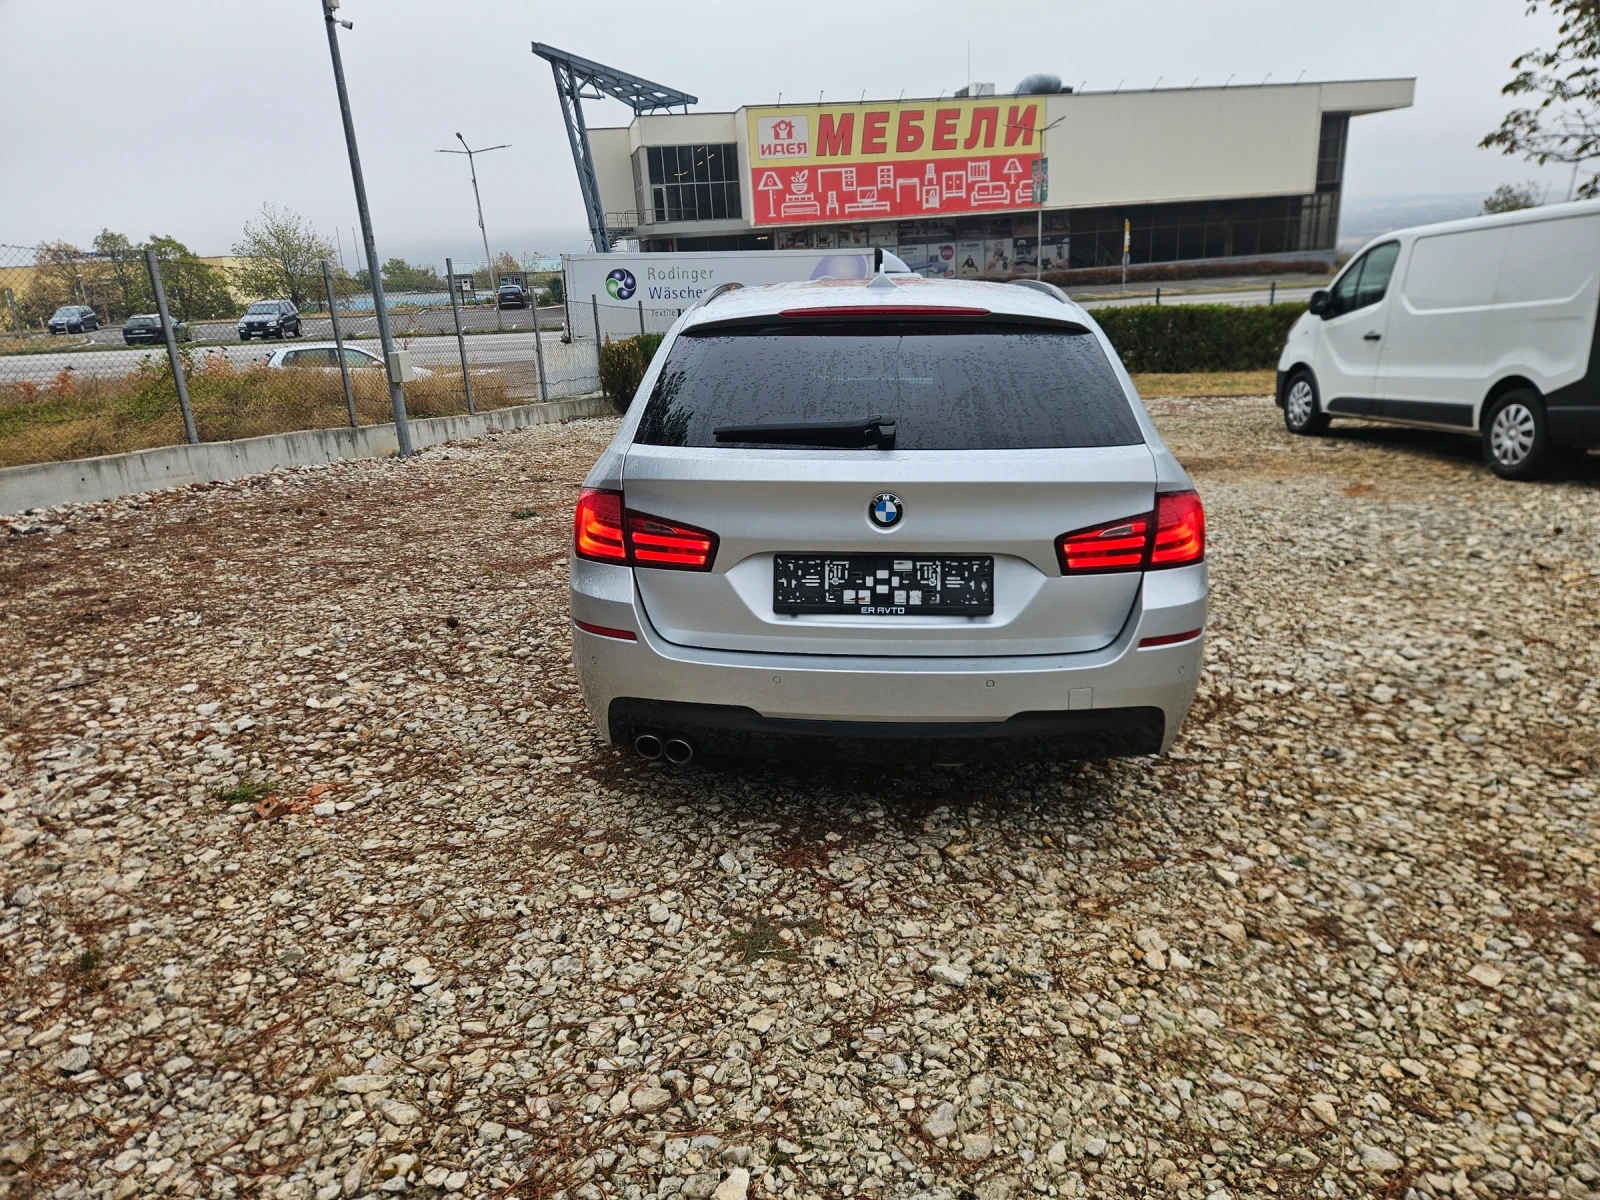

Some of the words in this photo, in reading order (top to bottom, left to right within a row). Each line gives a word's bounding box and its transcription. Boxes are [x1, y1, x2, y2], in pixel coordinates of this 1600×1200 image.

[816, 104, 1038, 156] МЕБЕЛИ
[760, 142, 808, 156] ИДЕЯ
[647, 267, 714, 282] Rodinger
[651, 309, 676, 317] Textile
[872, 493, 903, 506] BMW
[861, 606, 875, 614] ER
[877, 606, 905, 614] AVTO
